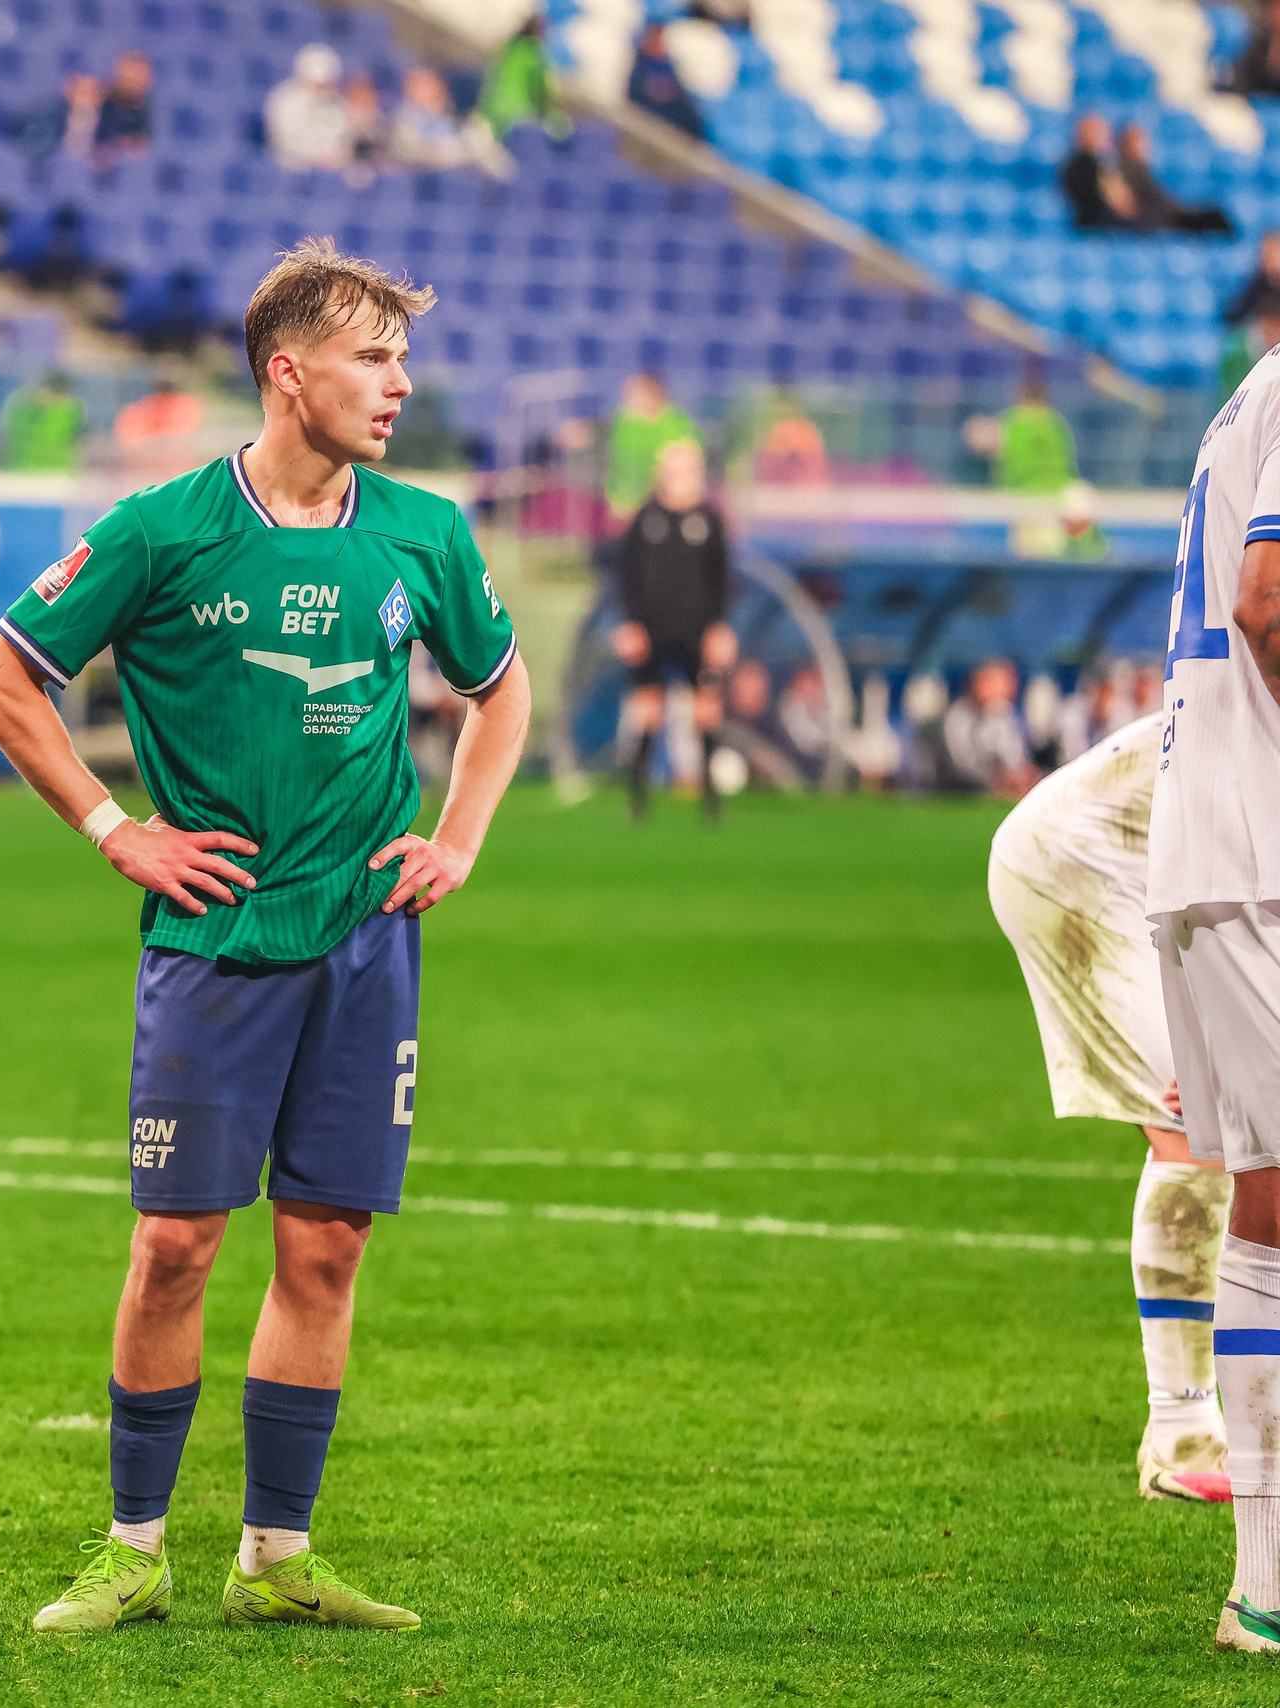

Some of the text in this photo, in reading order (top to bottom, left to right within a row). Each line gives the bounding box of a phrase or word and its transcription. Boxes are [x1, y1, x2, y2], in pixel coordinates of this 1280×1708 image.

[191, 592, 250, 626] wb
[280, 584, 341, 609] FON
[280, 611, 340, 635] BET
[392, 1039, 418, 1125] 2
[132, 1118, 177, 1143] FON
[132, 1144, 175, 1169] BET
